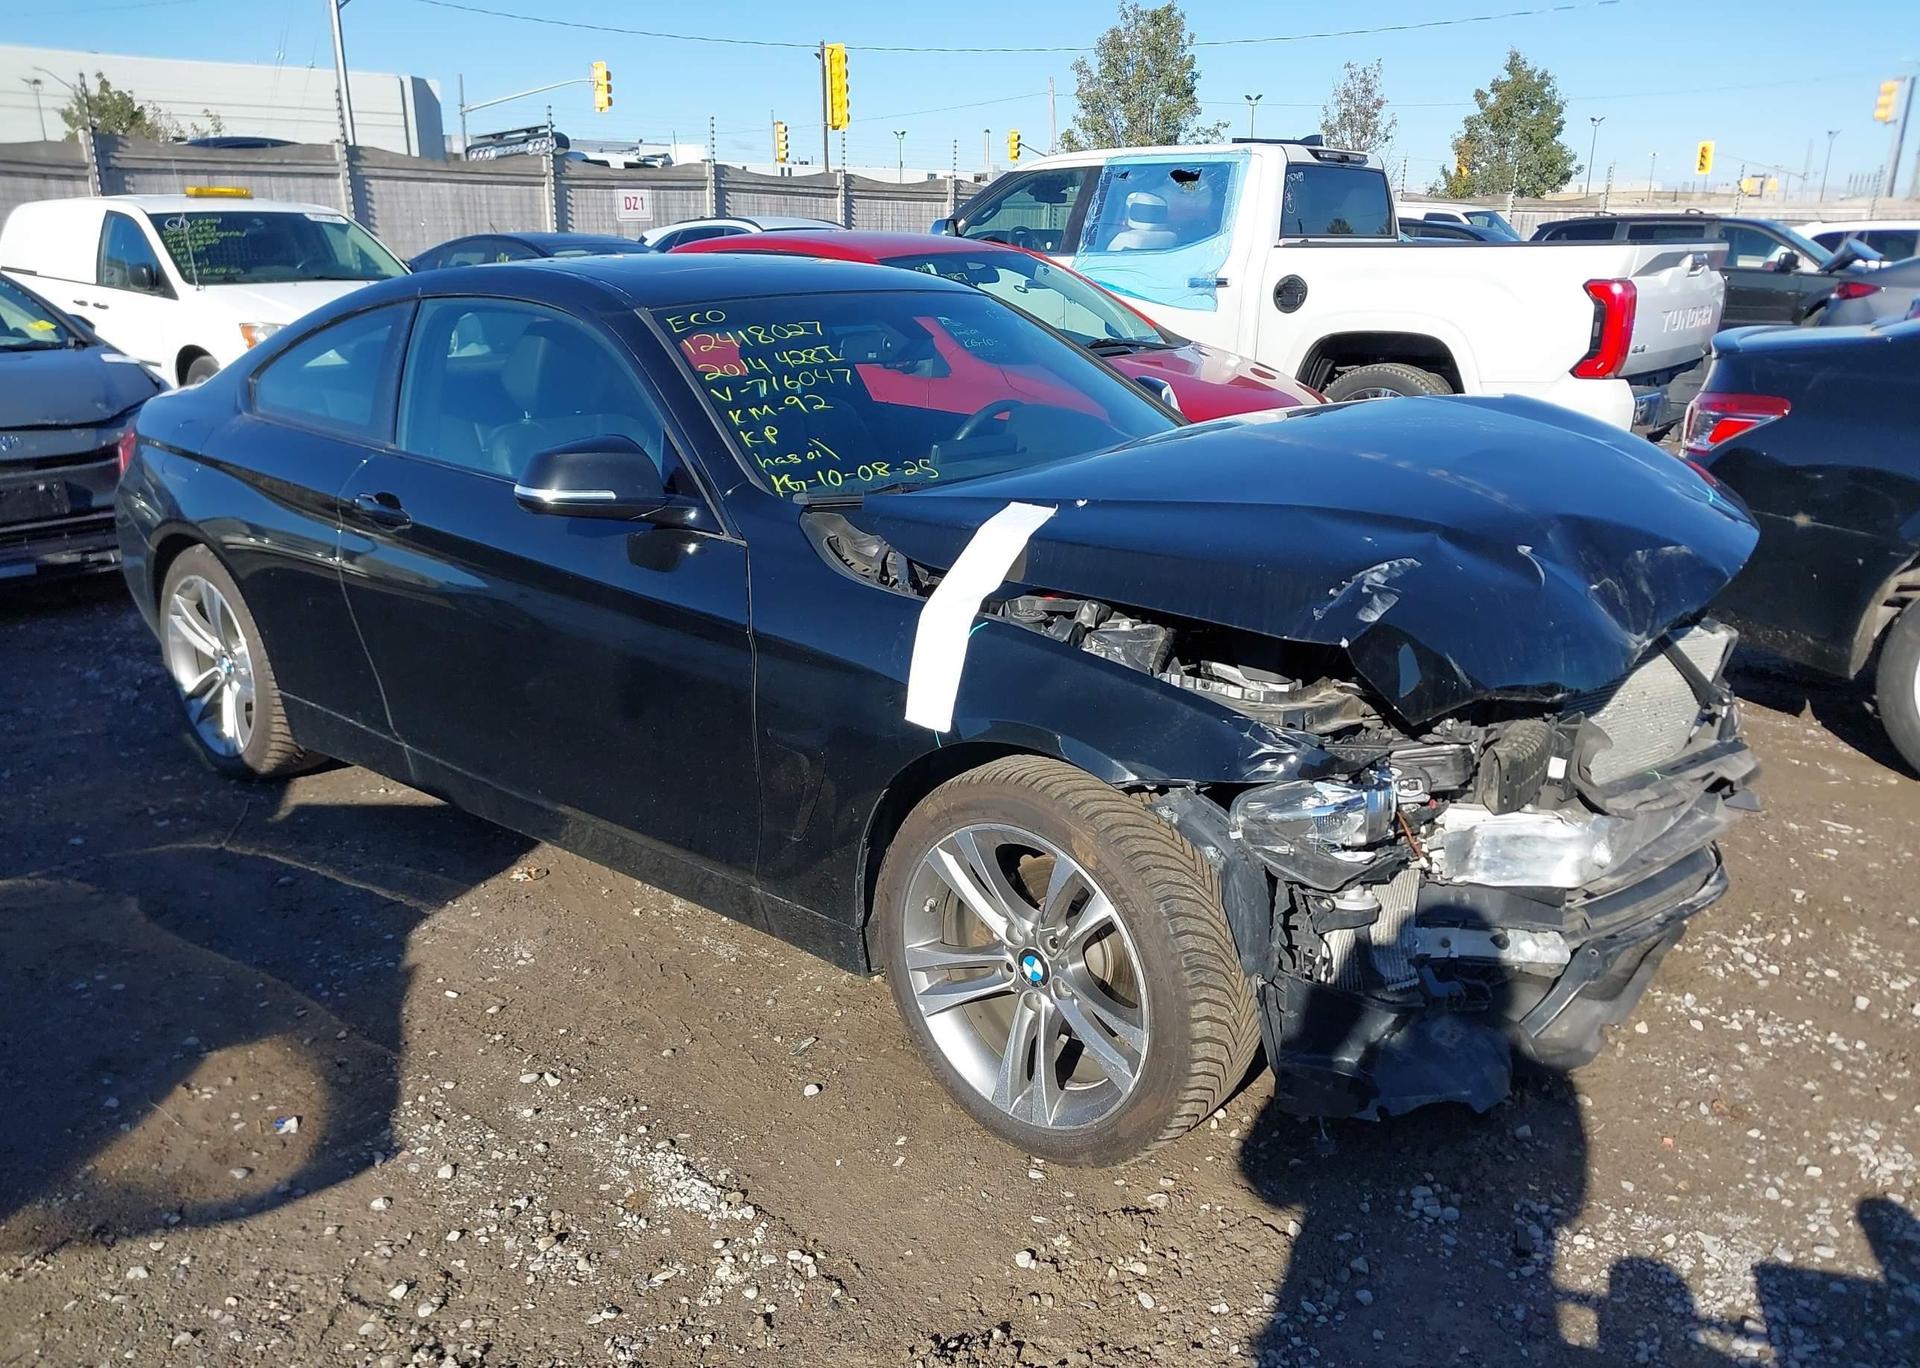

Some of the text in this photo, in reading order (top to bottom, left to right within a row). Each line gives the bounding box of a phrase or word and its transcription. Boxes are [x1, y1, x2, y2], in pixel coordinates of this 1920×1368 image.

[624, 196, 645, 211] DZ1
[666, 310, 726, 333] ECO
[1662, 305, 1713, 333] TUNDRA
[681, 321, 823, 354] 12418027
[697, 358, 772, 381] 2014
[729, 395, 834, 425] KM-92
[740, 425, 779, 447] KP
[771, 460, 939, 497] KG-10-08-25
